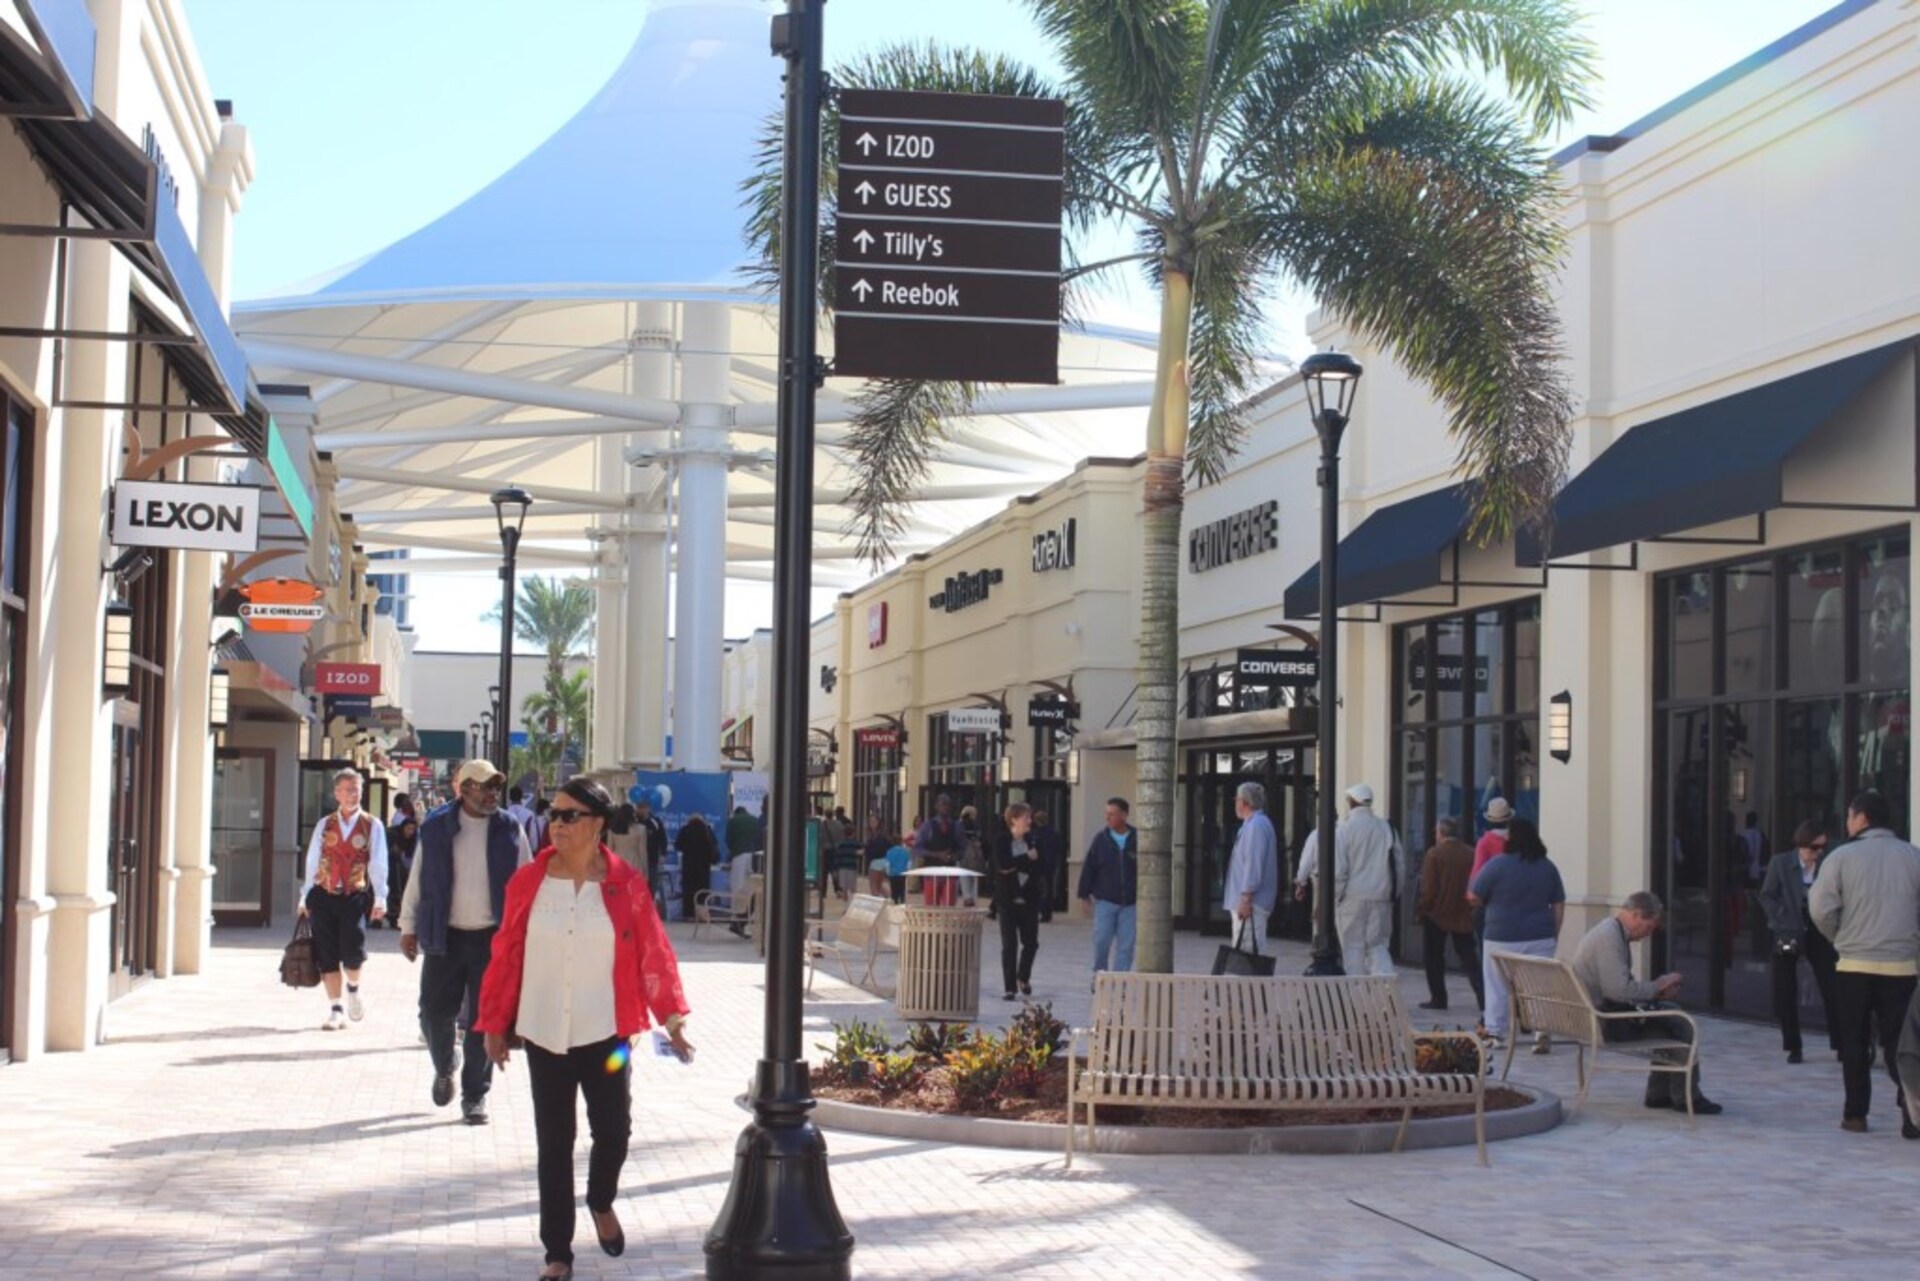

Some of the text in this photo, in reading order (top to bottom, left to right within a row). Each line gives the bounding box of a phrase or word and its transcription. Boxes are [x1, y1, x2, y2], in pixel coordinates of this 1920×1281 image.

[886, 134, 935, 159] IZOD
[884, 183, 952, 208] GUESS
[883, 231, 944, 261] Tilly's
[882, 280, 960, 307] Reebok
[129, 499, 244, 533] LEXON
[1189, 499, 1278, 574] CONVERSE
[254, 607, 322, 616] LE CREUSET
[326, 672, 370, 684] IZOD
[1240, 661, 1316, 675] CONVERSE
